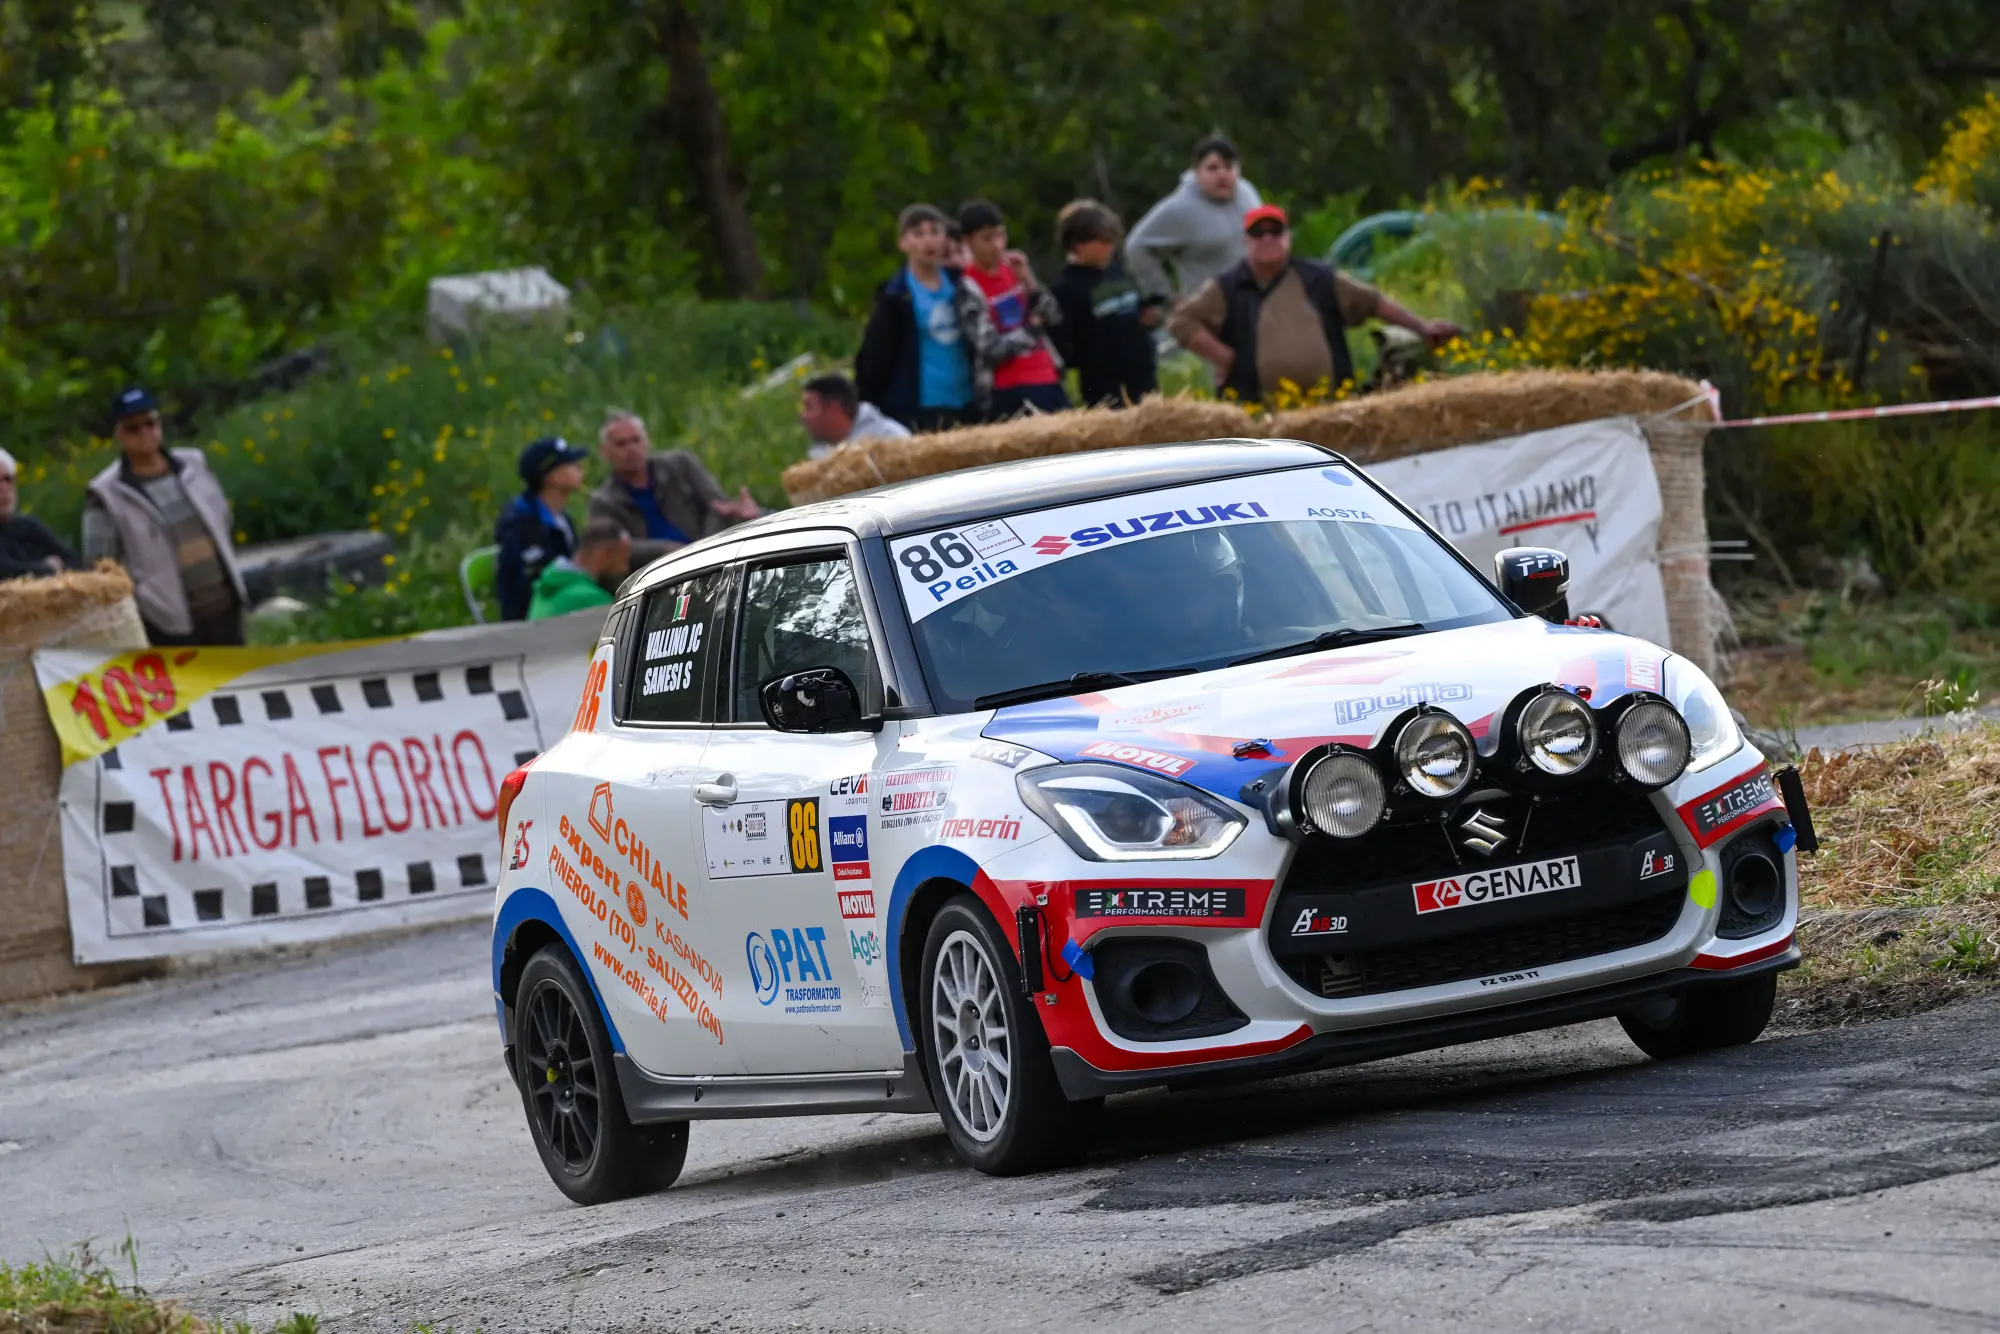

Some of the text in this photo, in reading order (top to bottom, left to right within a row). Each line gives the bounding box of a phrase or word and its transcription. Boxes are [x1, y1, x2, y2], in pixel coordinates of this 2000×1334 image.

[1307, 507, 1376, 521] AOSTA
[1475, 474, 1596, 529] ITALIANO
[1070, 501, 1269, 547] SUZUKI
[899, 532, 974, 584] 86
[927, 559, 1020, 602] Peila
[645, 624, 690, 661] VALLINO
[72, 653, 176, 740] 109
[569, 659, 608, 735] 86
[642, 660, 693, 696] SANESI S
[1085, 741, 1186, 774] MOTUL
[149, 729, 499, 862] TARGA FLORIO
[845, 797, 868, 805] LOGISTICS
[893, 790, 936, 812] ERBETTA
[1701, 774, 1771, 823] EXTREME
[1716, 793, 1771, 825] PERFORMANCE TYRES
[790, 801, 819, 870] 86
[833, 831, 856, 846] Allianz
[940, 815, 1021, 841] meverin
[559, 814, 620, 898] expert
[614, 817, 689, 921] CHIALE
[1089, 891, 1227, 909] EXTREME
[1464, 858, 1576, 902] GENART
[842, 894, 874, 916] MOTUL
[1105, 908, 1209, 916] PERFORMANCE TYRES
[549, 844, 608, 922] PINEROLO
[609, 909, 636, 954] (TO)
[646, 947, 699, 1014] SALUZZO
[697, 1000, 724, 1046] (CN)
[655, 915, 723, 1001] KASANOVA
[770, 926, 833, 983] PAT
[594, 940, 668, 1025] www.chiale.it
[785, 986, 841, 1001] TRASFORMATORI
[1479, 970, 1541, 987] FZ 938 TT
